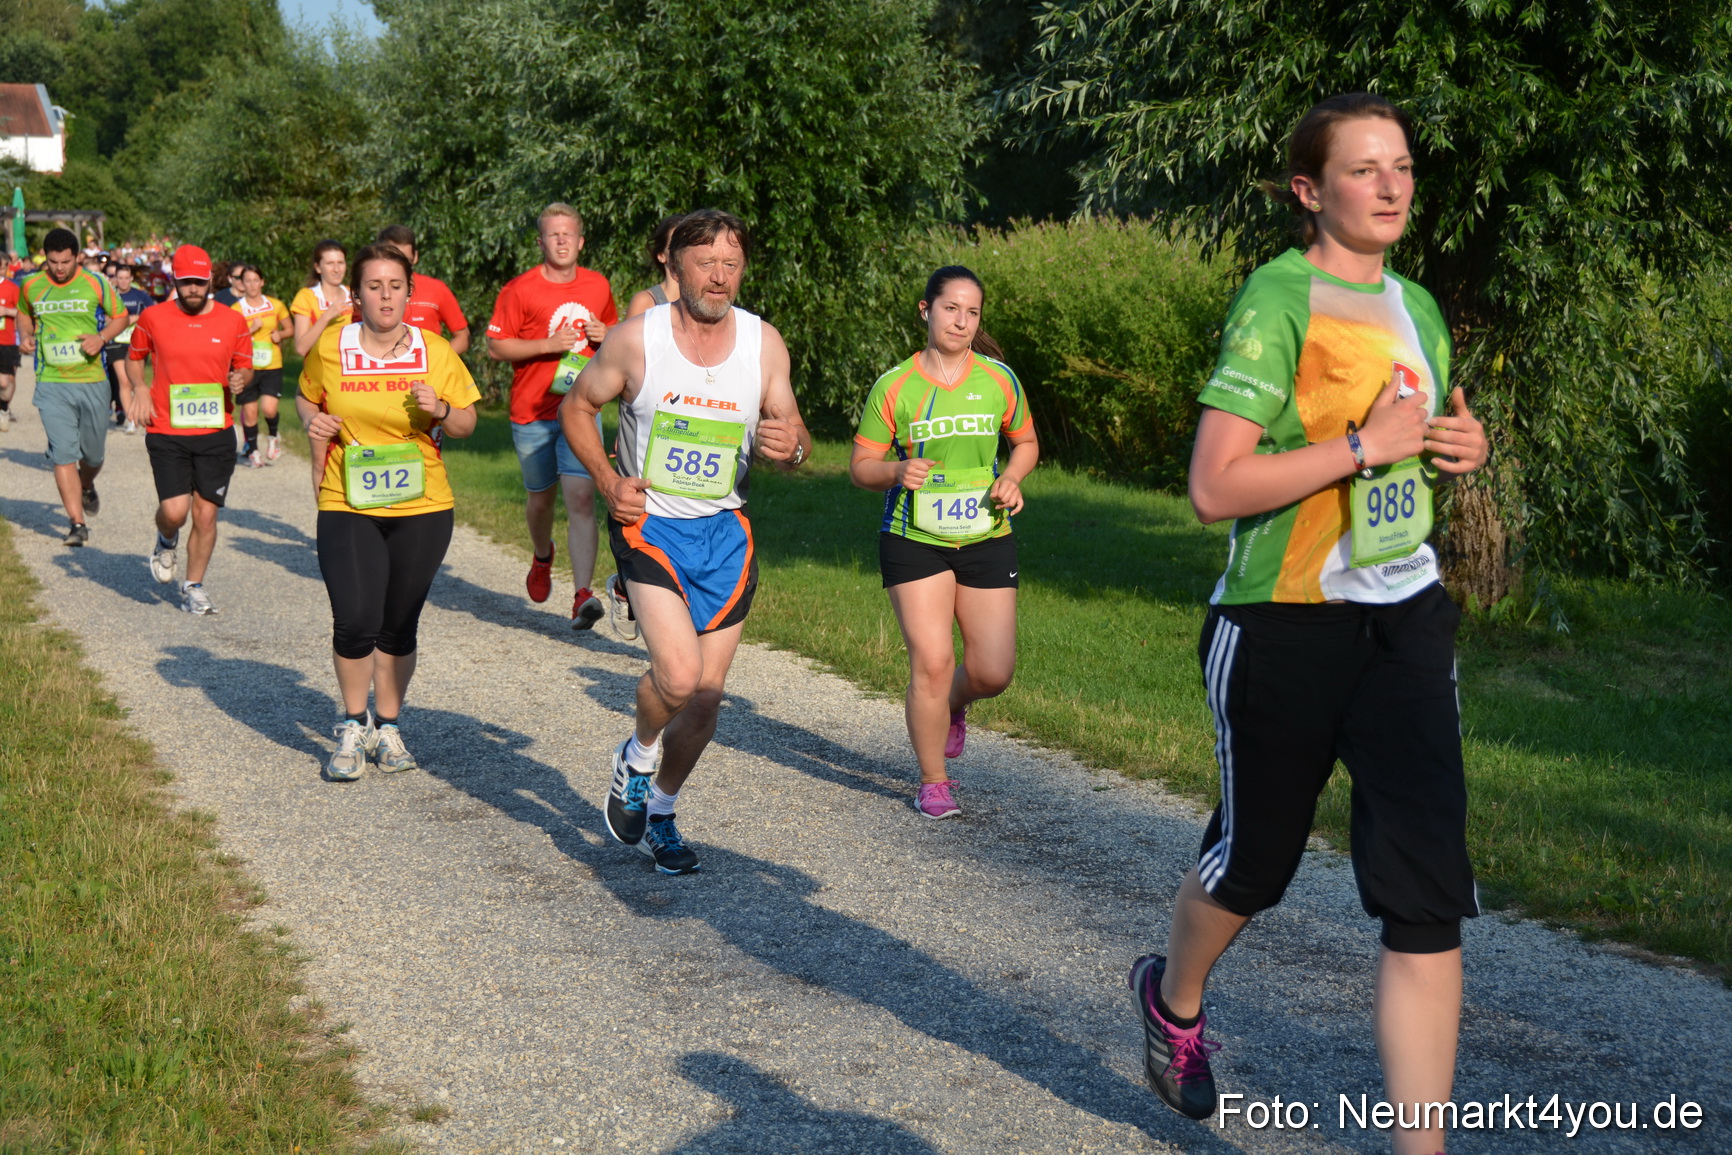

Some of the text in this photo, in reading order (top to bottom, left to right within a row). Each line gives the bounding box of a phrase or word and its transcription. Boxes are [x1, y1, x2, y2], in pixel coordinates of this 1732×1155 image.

[33, 300, 89, 315] BOCK
[51, 344, 76, 357] 141
[1222, 366, 1259, 386] Genuss
[340, 381, 380, 392] MAX
[177, 401, 219, 416] 1048
[683, 395, 742, 412] KLEBL
[910, 415, 995, 442] BOCK
[664, 446, 722, 478] 585
[362, 468, 410, 490] 912
[932, 497, 978, 520] 148
[1367, 478, 1416, 528] 988
